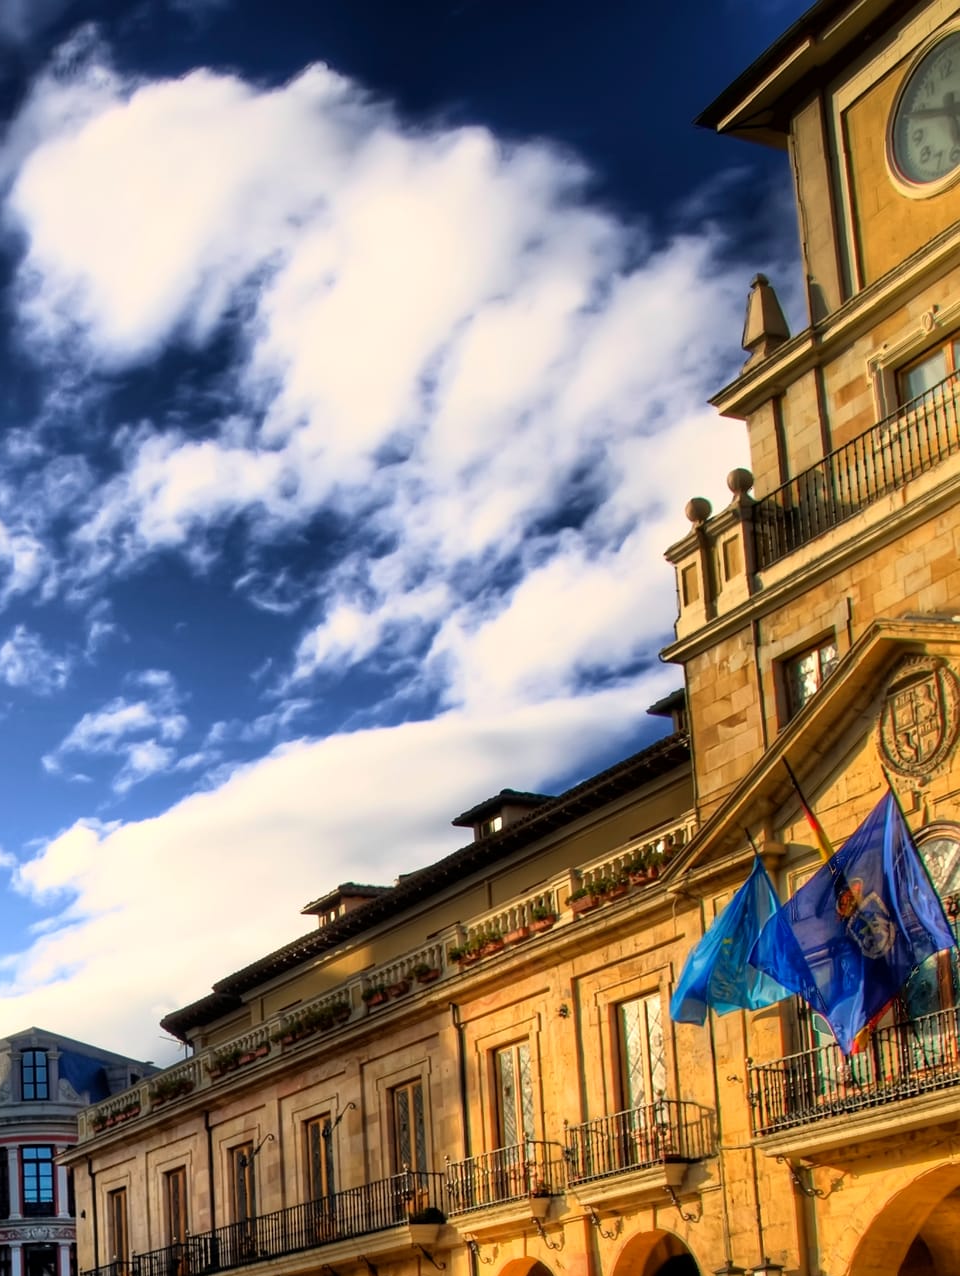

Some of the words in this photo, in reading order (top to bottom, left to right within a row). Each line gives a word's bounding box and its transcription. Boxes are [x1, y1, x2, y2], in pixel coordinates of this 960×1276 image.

[940, 58, 952, 80] 12
[912, 128, 924, 146] 9
[919, 145, 931, 164] 8
[933, 150, 943, 169] 7
